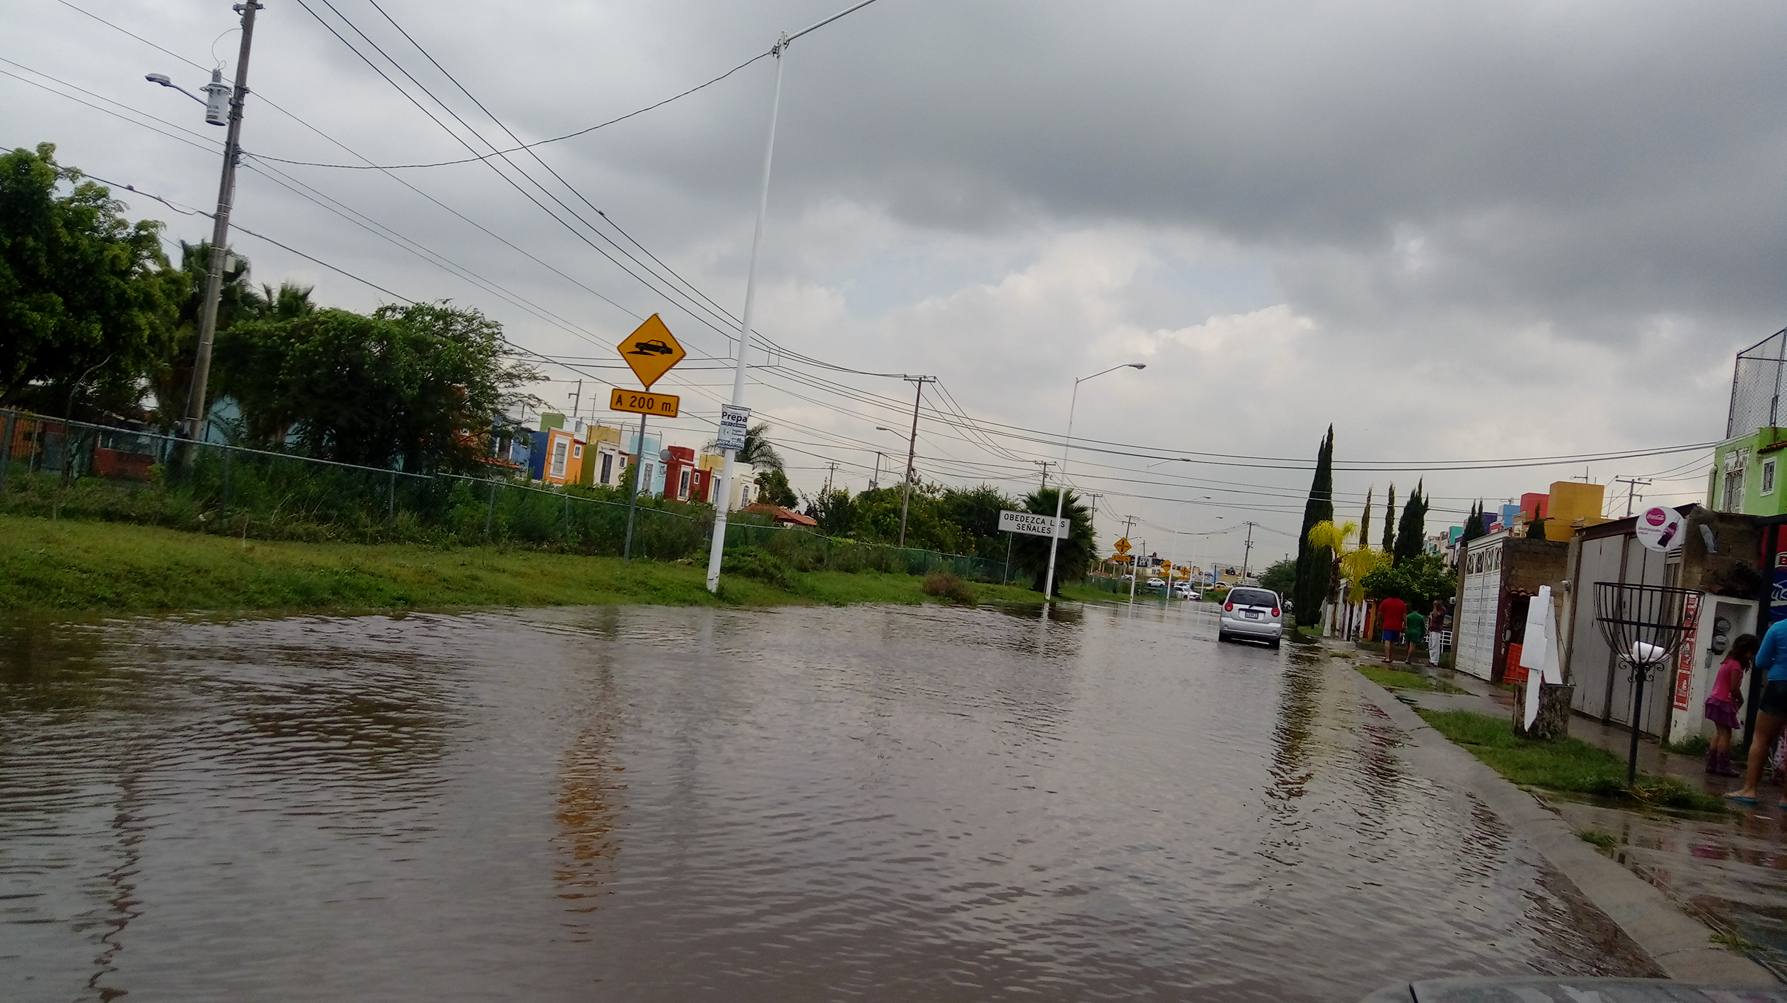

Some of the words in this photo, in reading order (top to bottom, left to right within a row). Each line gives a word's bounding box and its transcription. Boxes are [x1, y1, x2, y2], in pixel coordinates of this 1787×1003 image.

[615, 395, 623, 406] A
[629, 395, 655, 410] 200
[661, 401, 675, 413] m.
[721, 411, 748, 423] Prepa
[1003, 513, 1046, 525] OBEDEZCA
[1049, 519, 1066, 528] LS
[1016, 523, 1052, 534] SEÑALES
